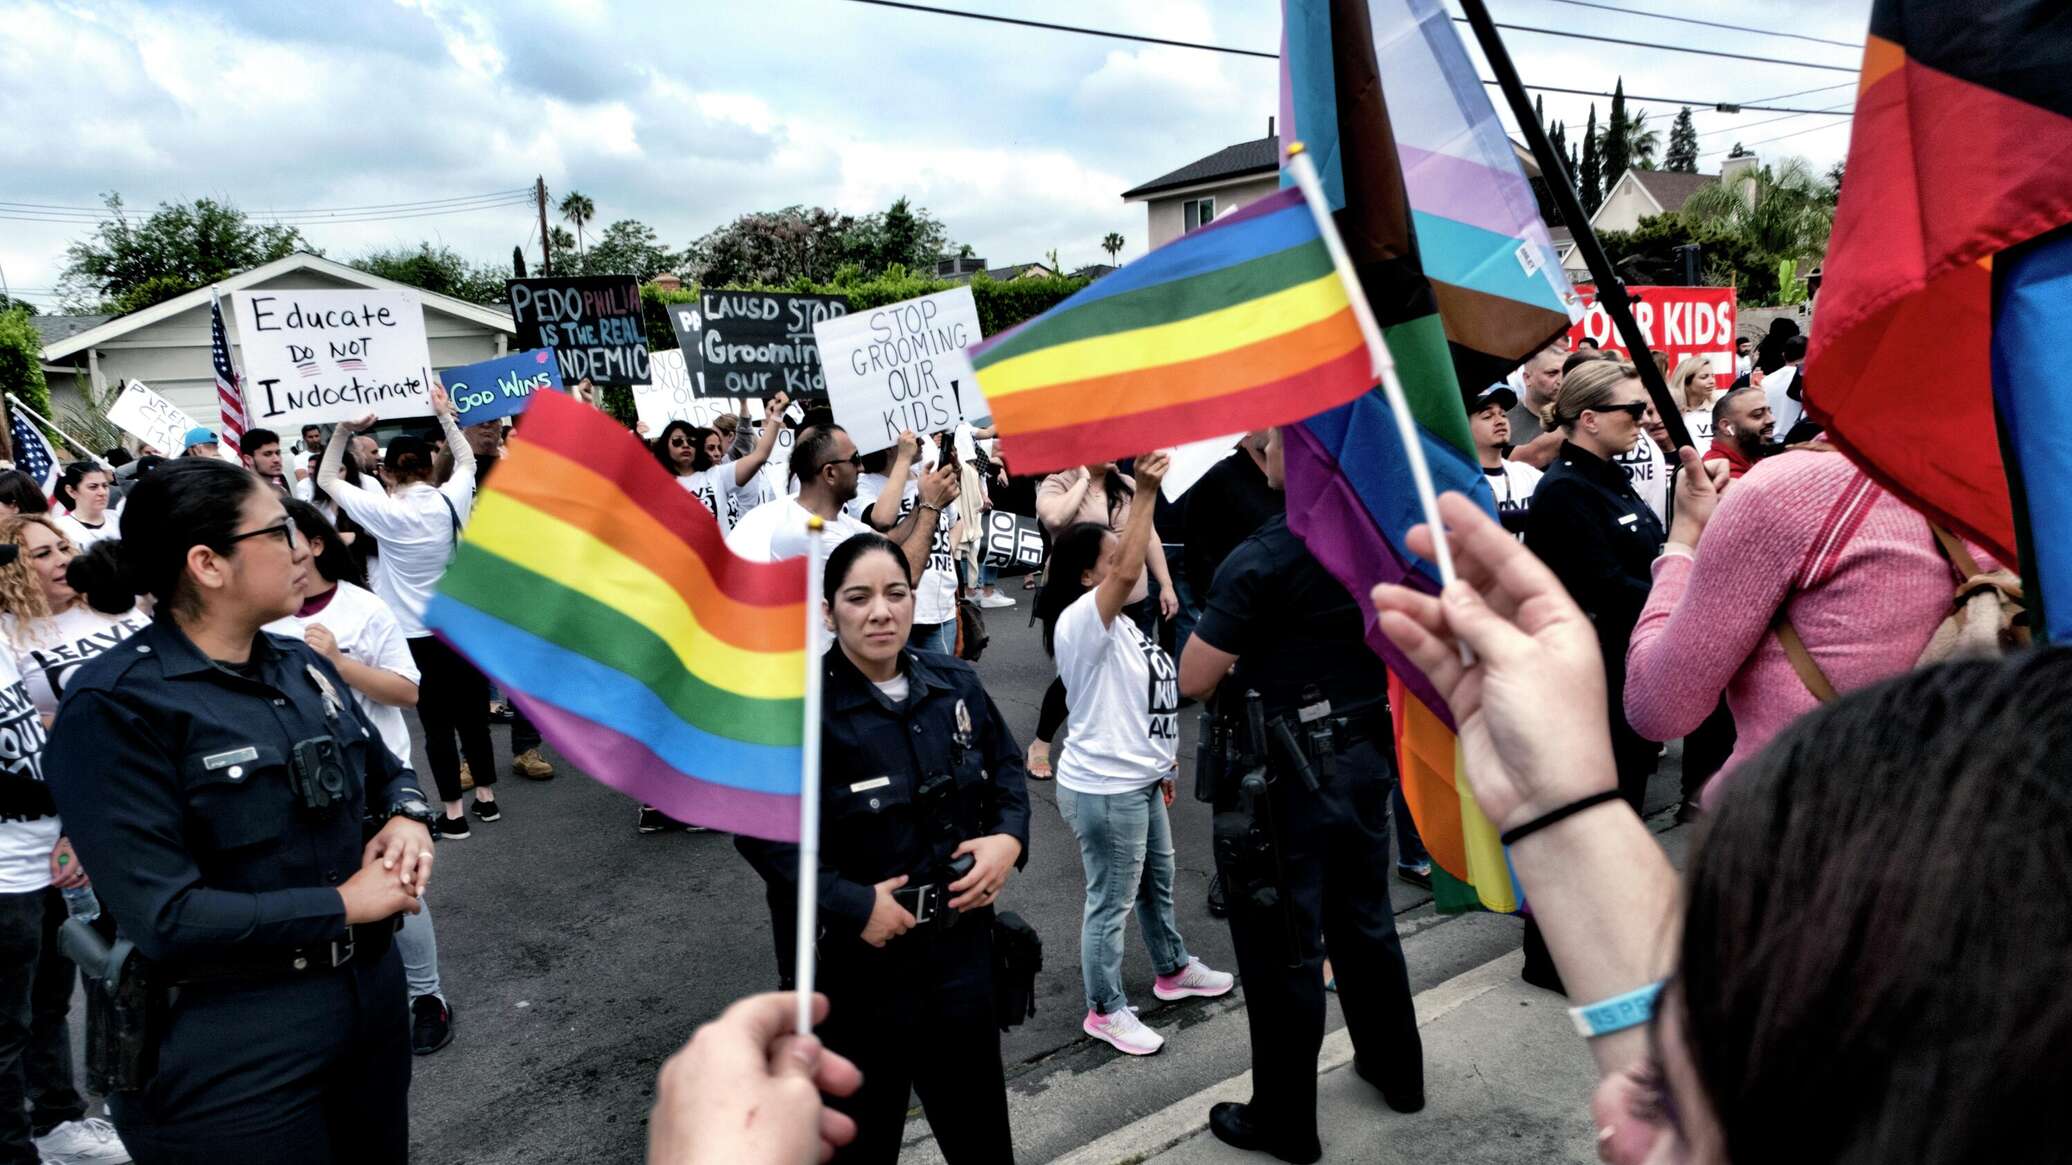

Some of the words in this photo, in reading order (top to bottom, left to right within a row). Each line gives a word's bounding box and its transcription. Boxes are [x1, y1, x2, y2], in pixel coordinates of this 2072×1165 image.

[252, 297, 396, 331] Educate
[511, 283, 640, 323] PEDOPHILIA
[704, 295, 779, 321] LAUSD
[787, 297, 847, 333] STOP
[870, 300, 937, 343] STOP
[539, 324, 559, 346] IS
[560, 322, 598, 345] THE
[600, 316, 647, 345] REAL
[1664, 302, 1731, 346] KIDS
[286, 344, 314, 363] DO
[329, 337, 372, 358] NOT
[558, 344, 650, 381] NDEMIC
[705, 329, 820, 364] Groomin
[852, 323, 967, 376] GROOMING
[450, 383, 495, 413] GOD
[498, 370, 552, 397] WINS
[784, 366, 825, 393] Kid
[888, 359, 939, 401] OUR
[985, 512, 1014, 567] OUR
